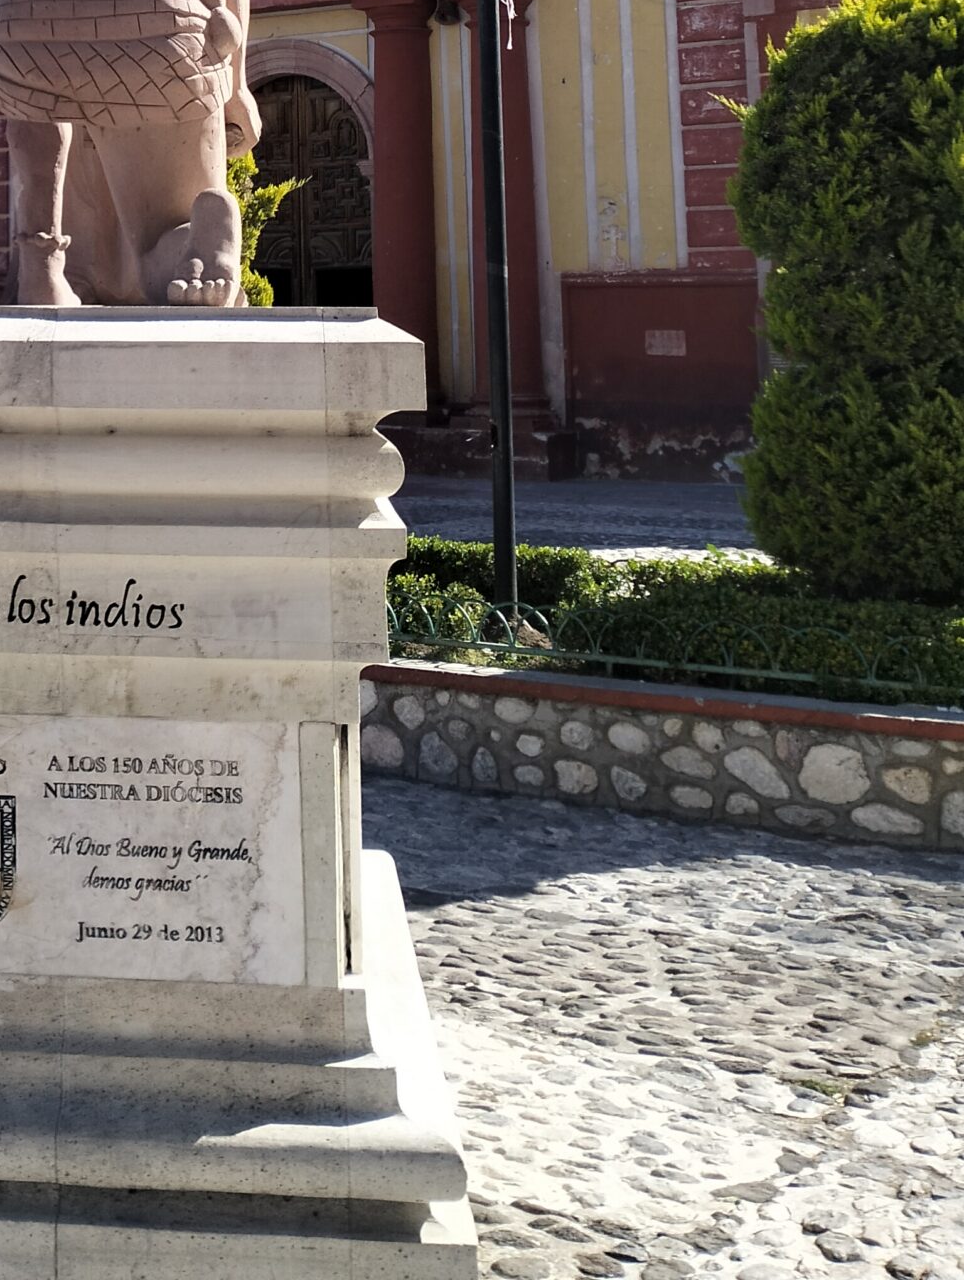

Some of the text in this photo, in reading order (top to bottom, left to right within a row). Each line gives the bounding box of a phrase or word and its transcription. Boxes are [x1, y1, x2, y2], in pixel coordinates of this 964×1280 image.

[7, 574, 54, 624] los
[65, 578, 185, 629] indios
[47, 754, 240, 777] A LOS 150 AÑOS DE
[43, 780, 243, 804] NUESTRA DIÓCESIS
[75, 836, 111, 857] Dios
[116, 837, 167, 859] Bueno
[166, 846, 183, 870] y
[187, 838, 253, 863] Grande,
[82, 866, 131, 890] demos
[76, 921, 225, 943] Junio 29 de 2013
